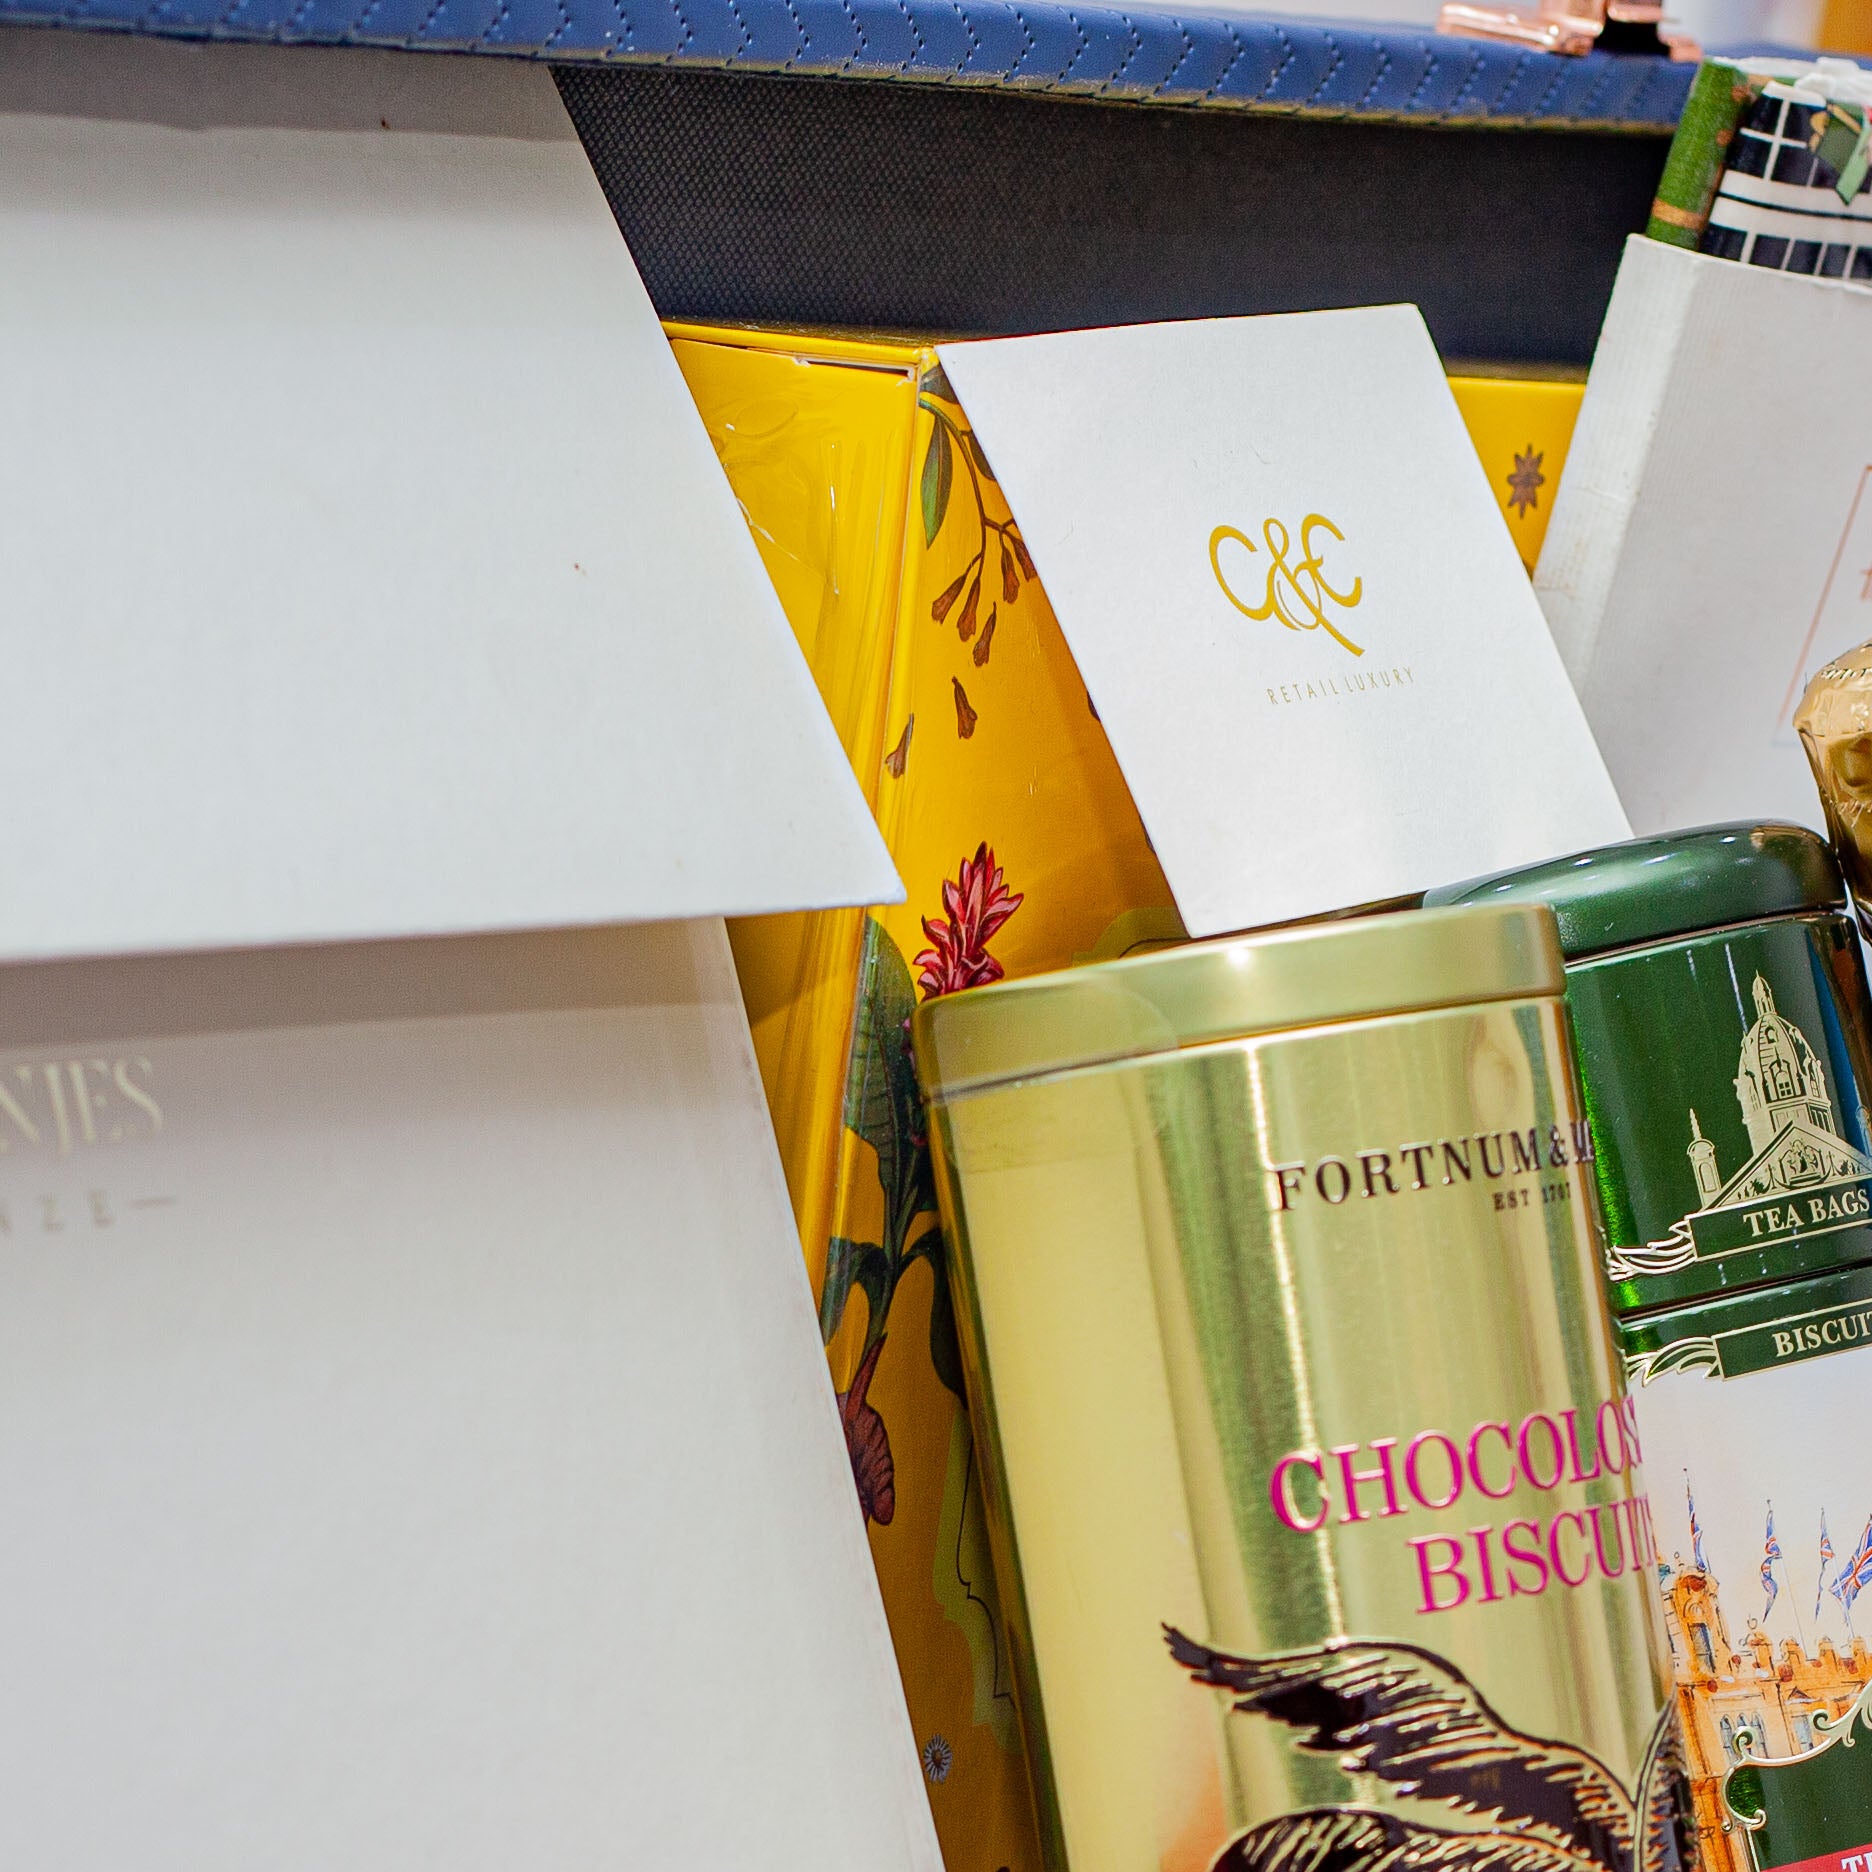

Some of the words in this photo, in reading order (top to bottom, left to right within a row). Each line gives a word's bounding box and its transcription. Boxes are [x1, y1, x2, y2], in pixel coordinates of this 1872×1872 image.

[1266, 678, 1339, 705] RETAIL
[1343, 666, 1414, 693] LUXURY
[1273, 1127, 1542, 1212] FORTNUM
[1492, 1187, 1530, 1212] EST
[1742, 1203, 1806, 1238] TEA
[1807, 1188, 1871, 1224] BAGS
